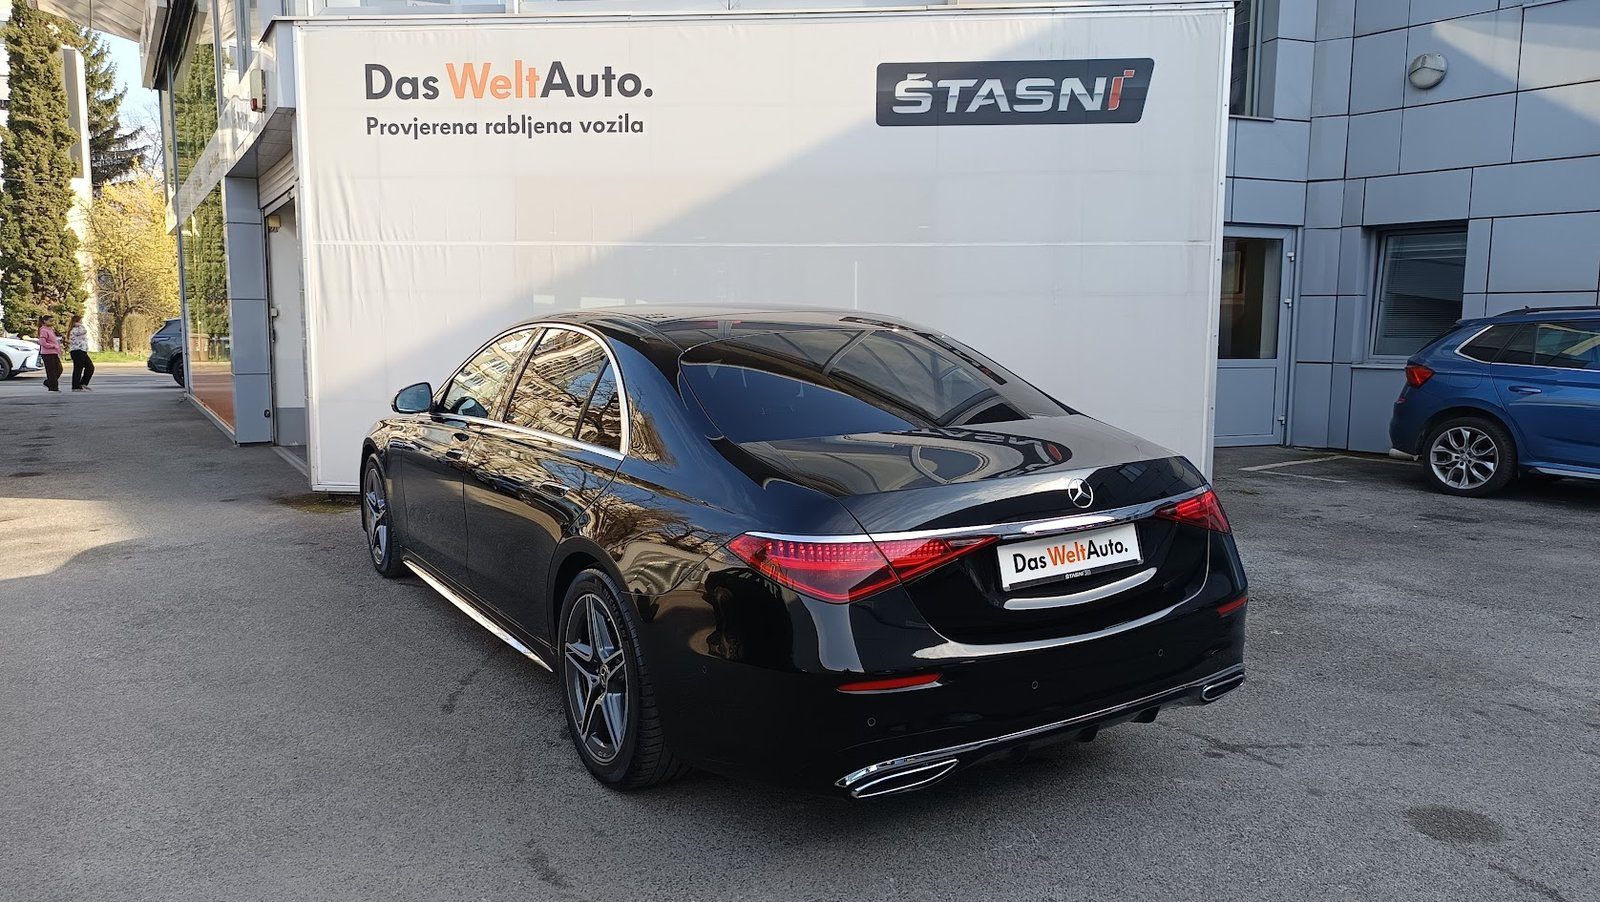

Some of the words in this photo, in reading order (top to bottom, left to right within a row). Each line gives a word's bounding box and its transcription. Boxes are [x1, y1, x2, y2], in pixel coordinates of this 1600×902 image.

[365, 64, 439, 100] Das
[446, 60, 653, 100] WeltAuto.
[366, 117, 478, 140] Provjerena
[485, 114, 572, 139] rabljena
[579, 113, 644, 133] vozila
[1013, 553, 1047, 573] Das
[1047, 539, 1128, 566] WeltAuto.
